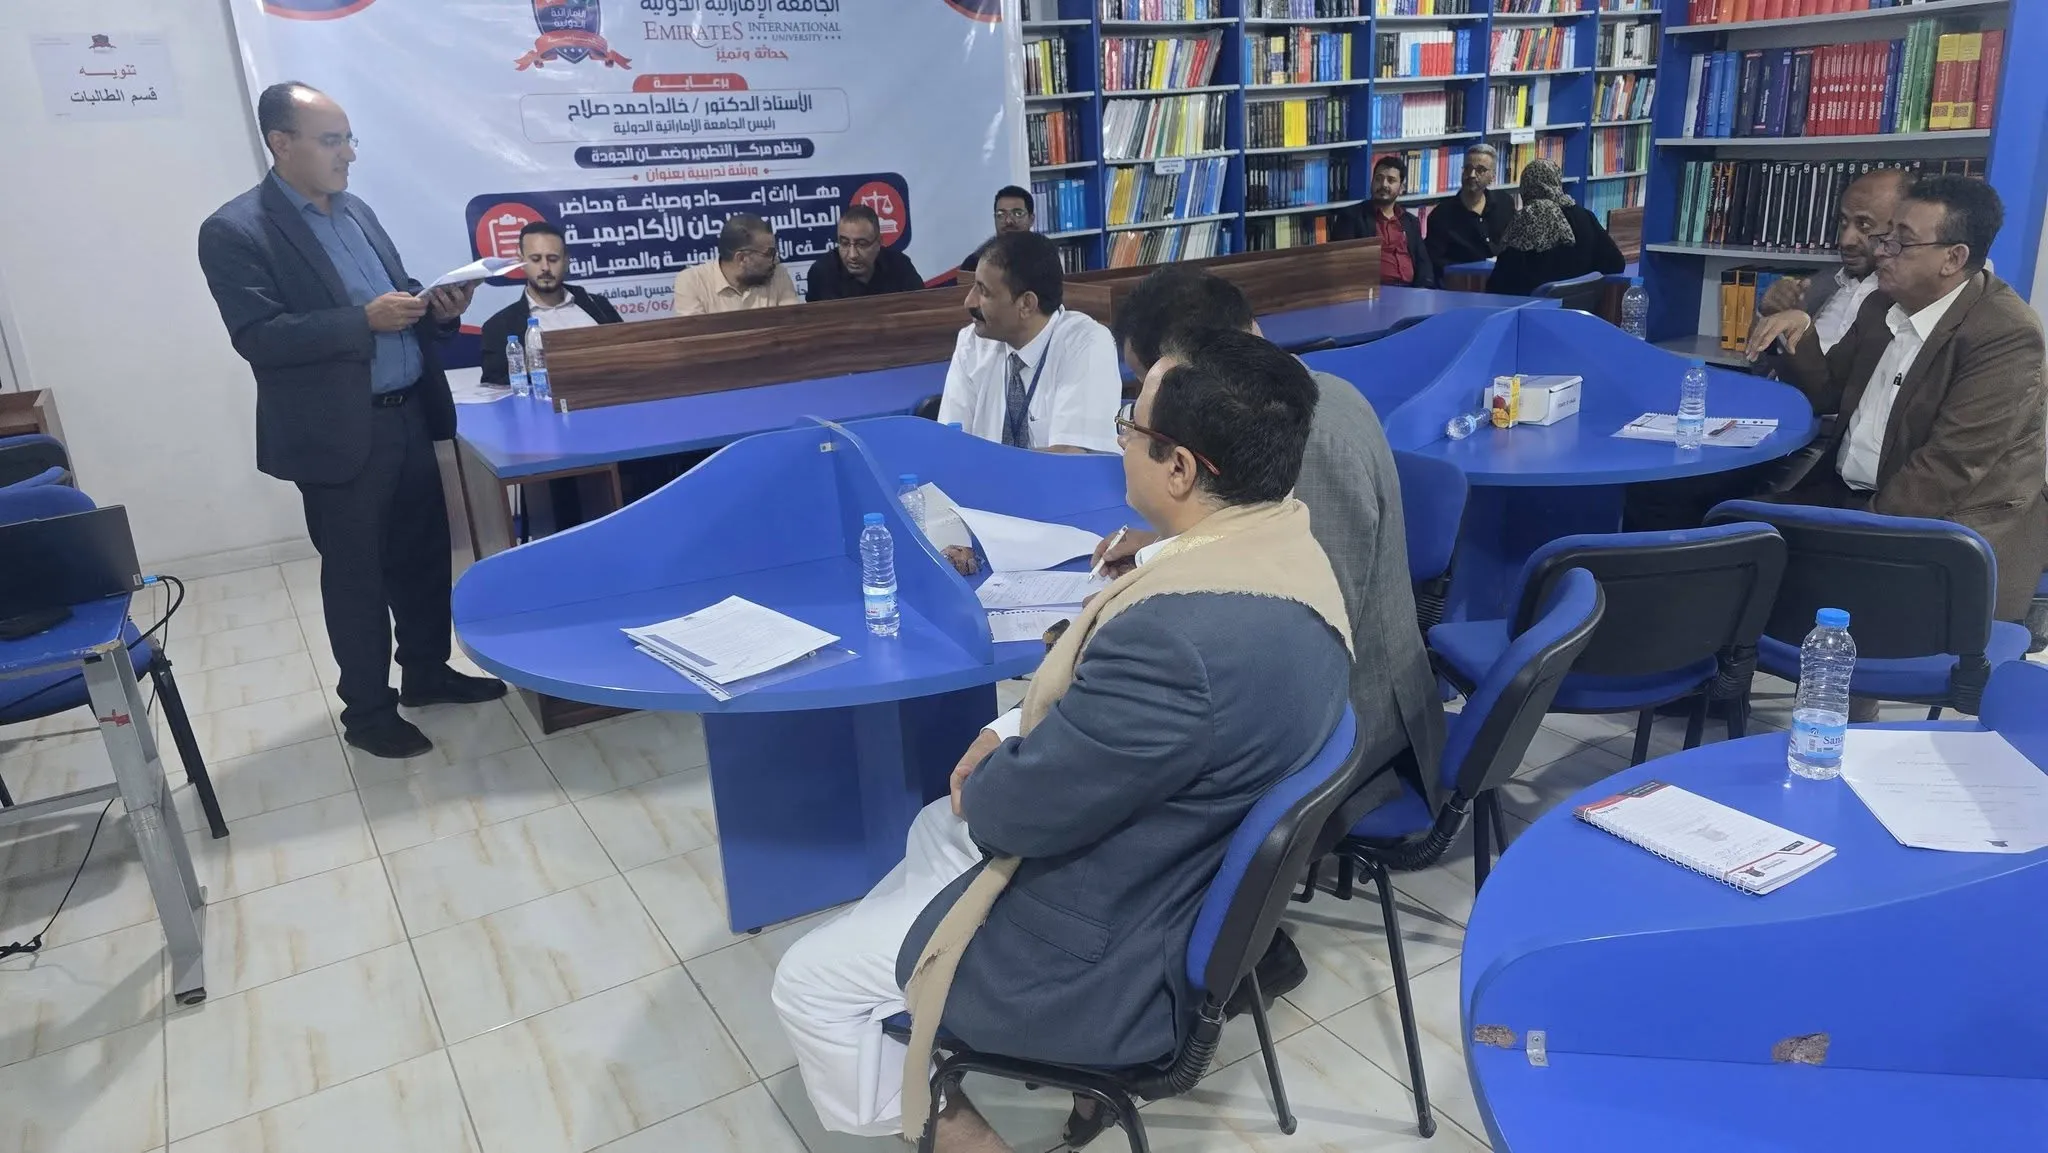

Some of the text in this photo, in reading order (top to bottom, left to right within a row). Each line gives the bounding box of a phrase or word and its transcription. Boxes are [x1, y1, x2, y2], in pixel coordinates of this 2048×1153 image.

[643, 21, 743, 48] EMIRATES
[748, 22, 841, 32] INTERNATIONAL
[754, 45, 788, 61] حداثة
[70, 87, 158, 106] قسم الطالبات
[705, 95, 760, 115] الدكتور
[763, 92, 812, 113] الأستاذ
[568, 98, 610, 122] صلاح
[613, 116, 775, 135] رئيس الجامعة الإماراتية الدولية
[591, 141, 802, 164] ينظم مركز التطوير وضمان الجودة
[646, 163, 758, 182] ورشة تدريبية بعنوان
[559, 184, 840, 219] مهارات إعداد وصياغة محاضر
[564, 213, 685, 248] الأكاديمية
[568, 251, 660, 277] والمعيارية
